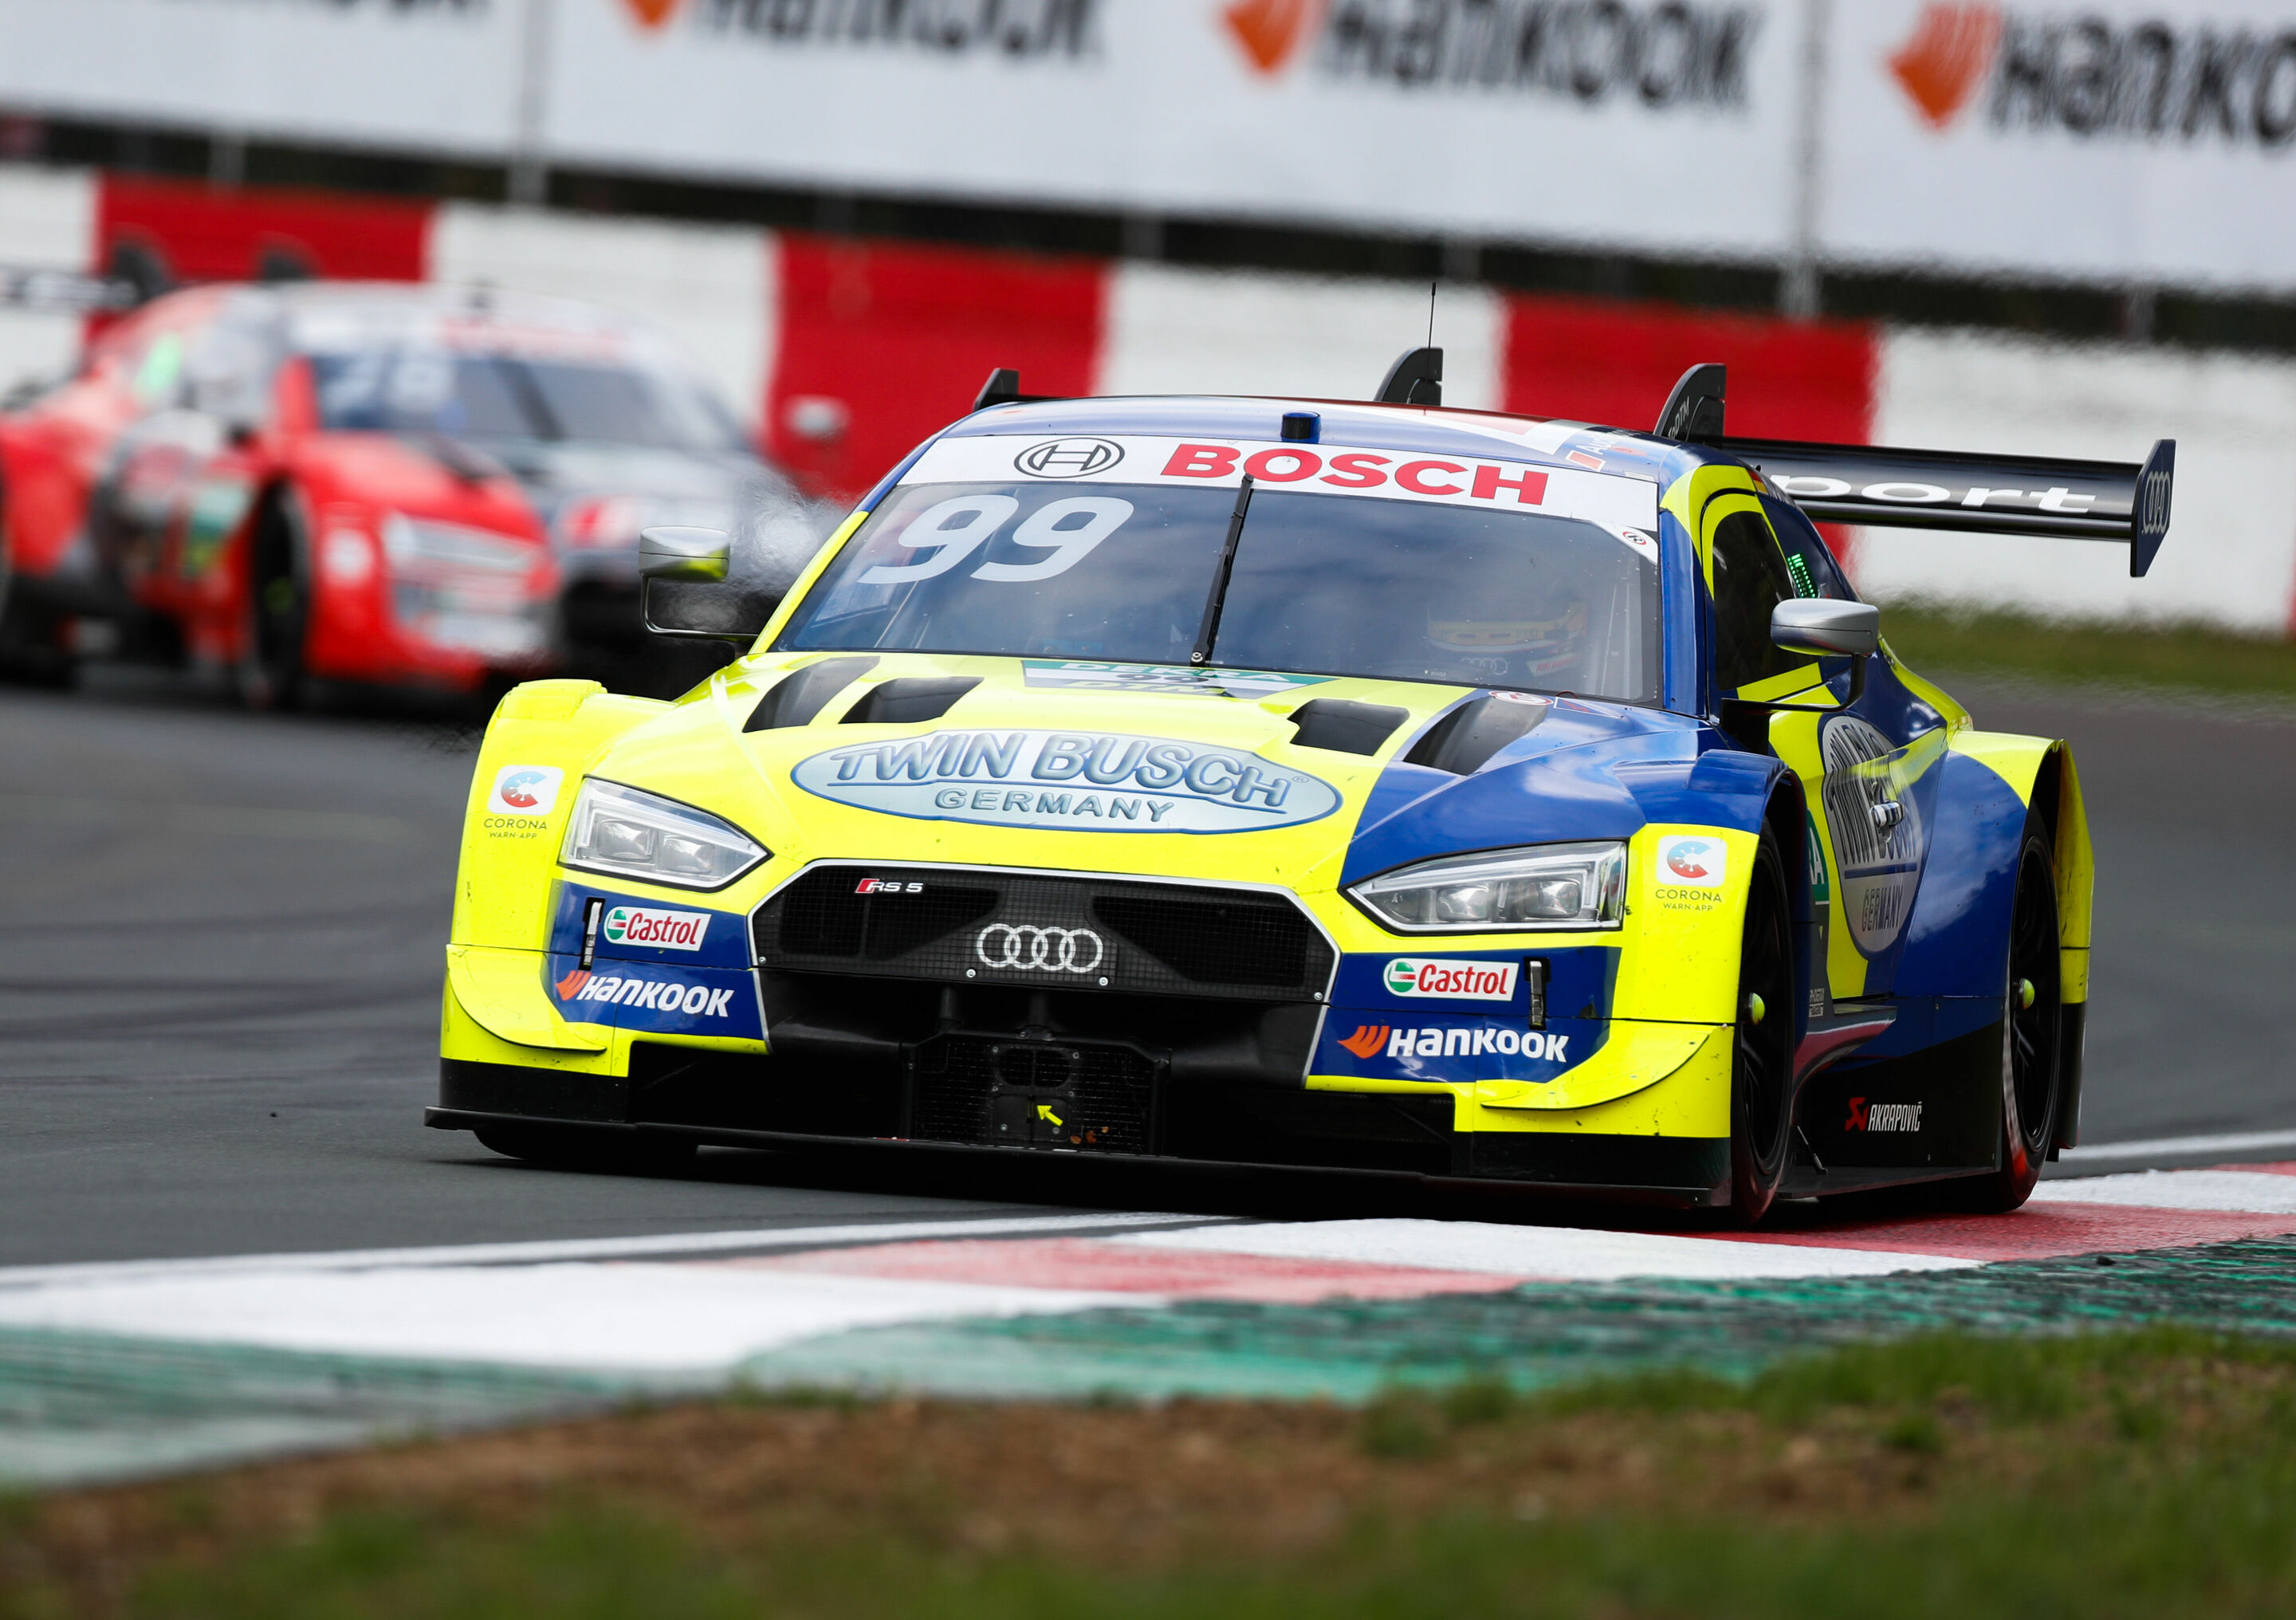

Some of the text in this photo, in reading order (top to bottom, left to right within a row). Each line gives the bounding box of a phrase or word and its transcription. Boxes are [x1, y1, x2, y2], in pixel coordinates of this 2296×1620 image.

[1161, 442, 1549, 506] BOSCH
[857, 494, 1134, 584] 99
[1060, 663, 1290, 682] DEKRA
[1116, 674, 1209, 683] 99
[1065, 681, 1228, 694] DTM
[830, 733, 1291, 808] TWIN BUSCH
[934, 788, 1174, 823] GERMANY
[483, 818, 547, 830] CORONA
[866, 881, 924, 893] RS 5
[1655, 889, 1722, 902] CORONA
[1663, 902, 1713, 911] WARN-APP
[1862, 885, 1904, 932] GERMANY
[627, 912, 702, 945] Castrol
[1418, 964, 1508, 995] Castrol
